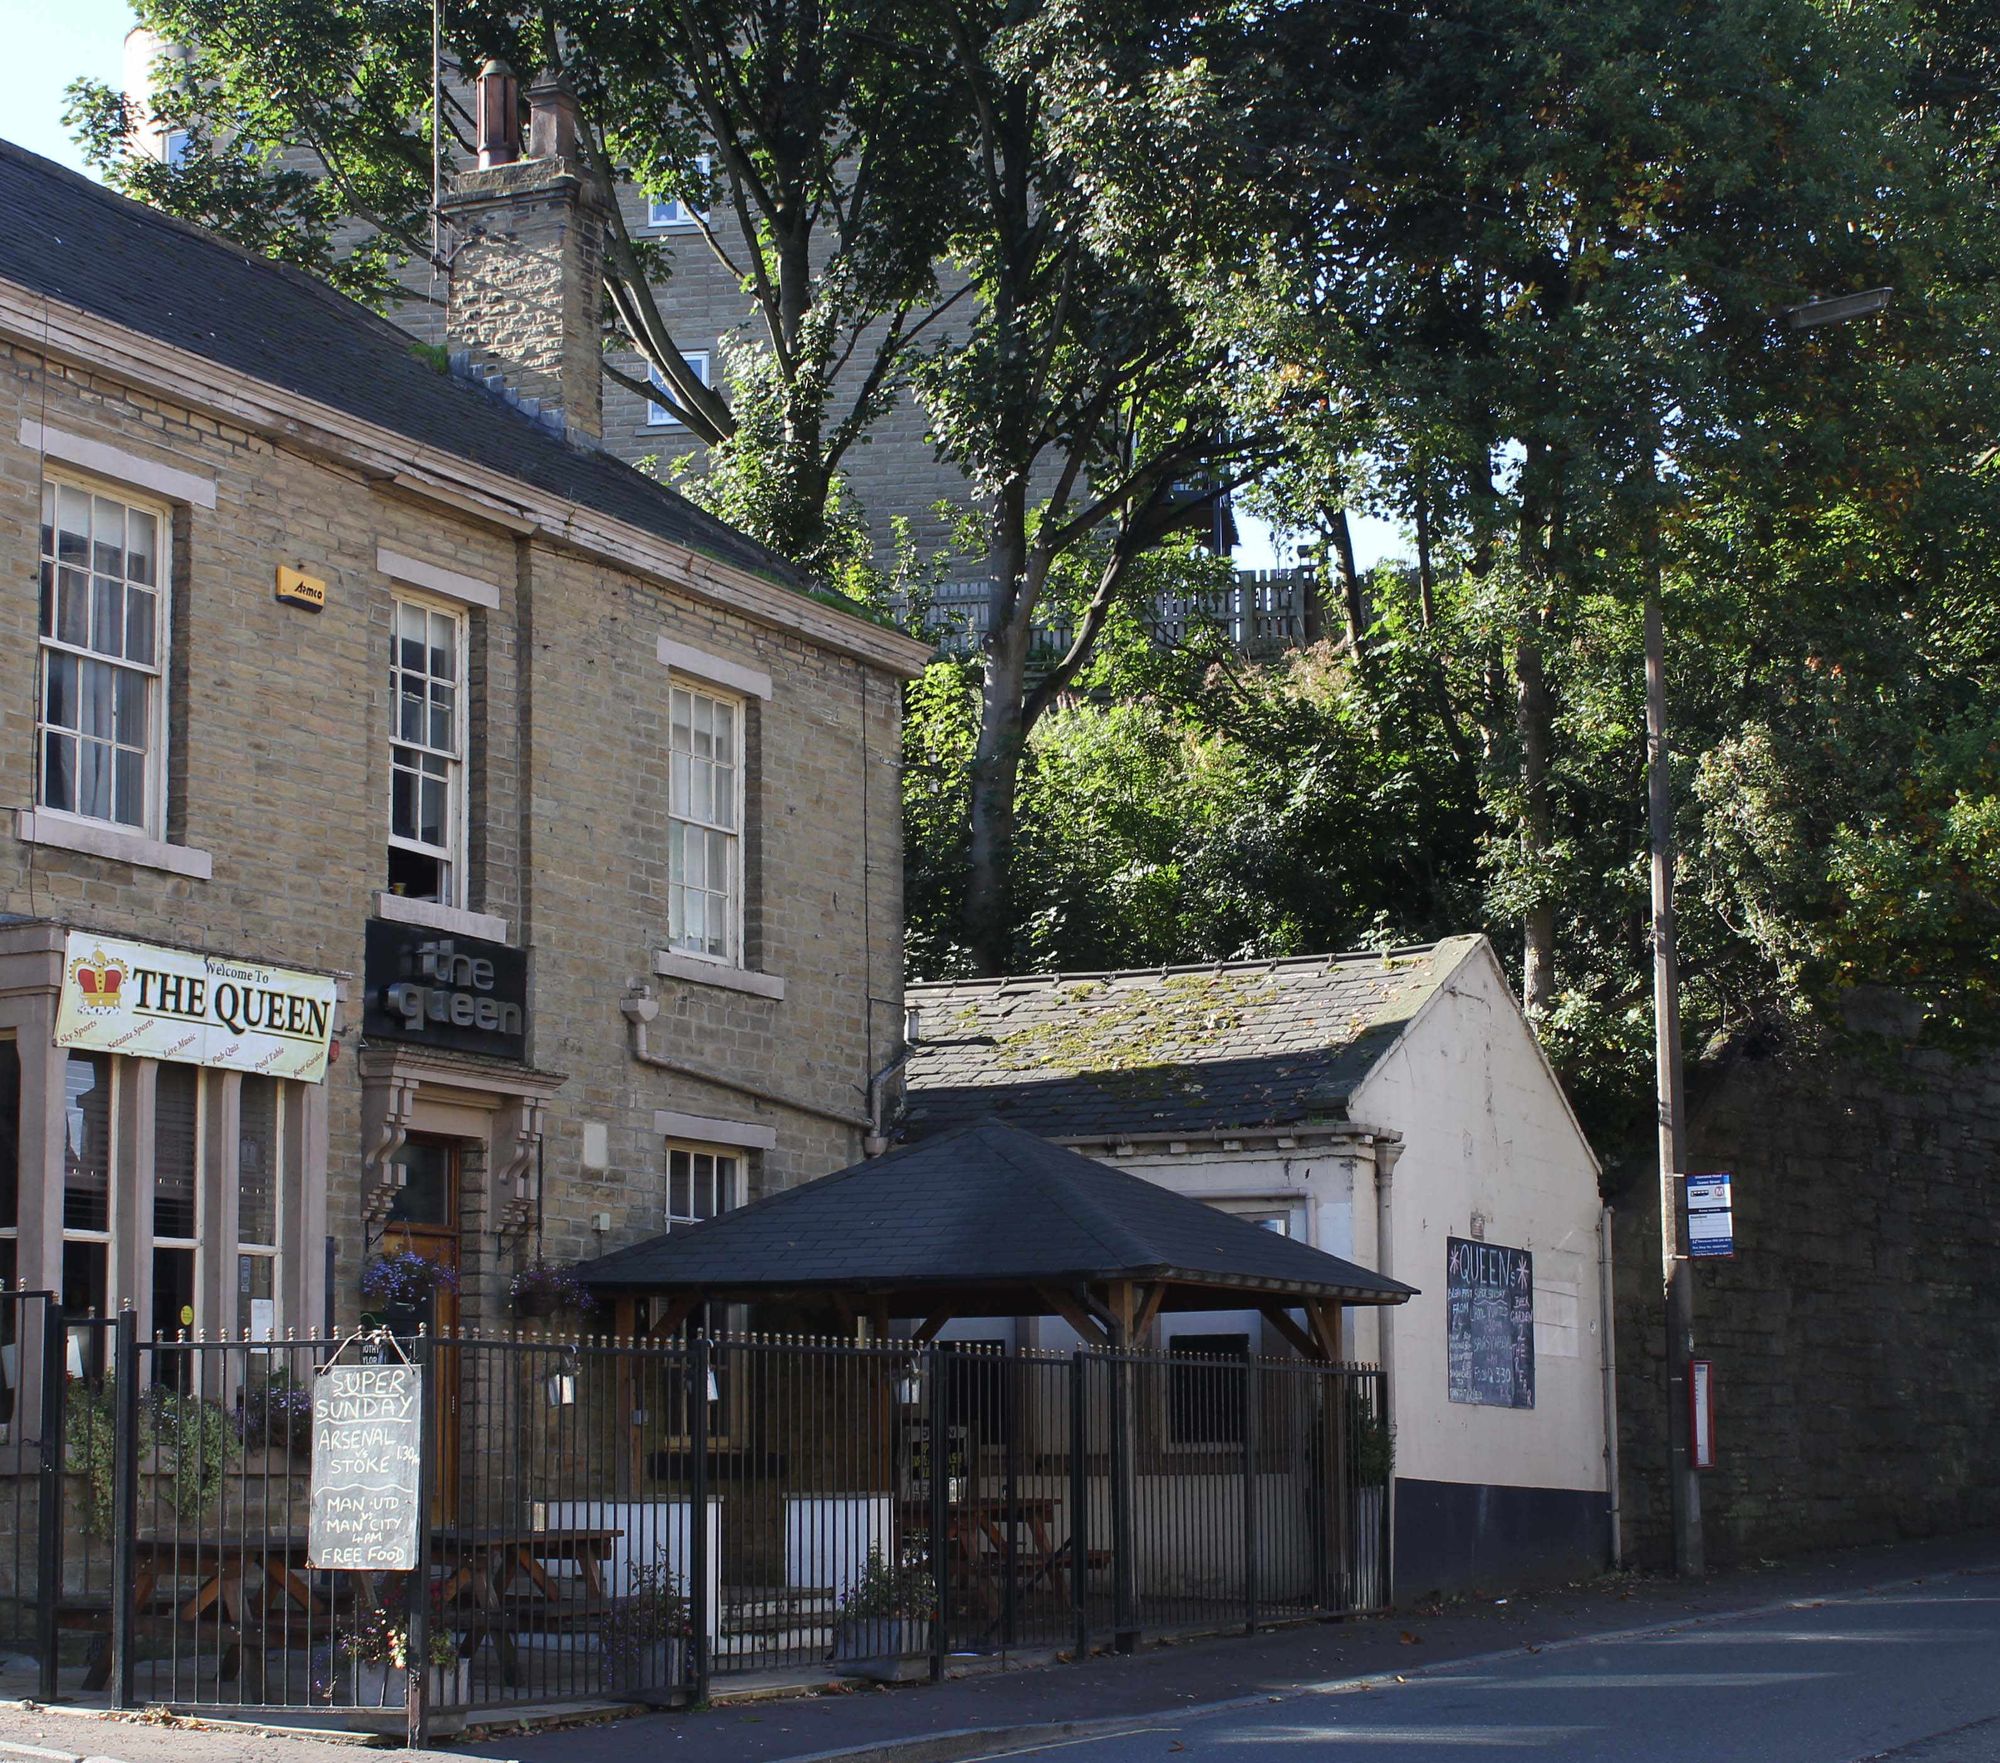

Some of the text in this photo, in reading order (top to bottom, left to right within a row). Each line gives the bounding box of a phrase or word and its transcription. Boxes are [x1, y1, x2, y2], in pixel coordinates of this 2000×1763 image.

[206, 961, 269, 985] Welcome To
[415, 939, 495, 991] the
[133, 968, 331, 1036] THE QUEEN
[387, 982, 523, 1036] queen
[59, 1019, 98, 1046] Sky Sports
[107, 1018, 155, 1050] Setanta Sports
[163, 1033, 197, 1059] Live Music
[212, 1042, 240, 1065] Pub Quiz
[255, 1046, 285, 1072] Pool Table
[293, 1050, 325, 1078] Beer Garden
[331, 1370, 405, 1395] SUPER
[316, 1396, 414, 1419] SUNDAY
[318, 1429, 396, 1452] ARSENAL
[331, 1456, 391, 1475] STOKE
[327, 1496, 400, 1512] MAN UTD
[326, 1517, 403, 1534] MAN CITY
[321, 1545, 405, 1564] FREE FOOD
